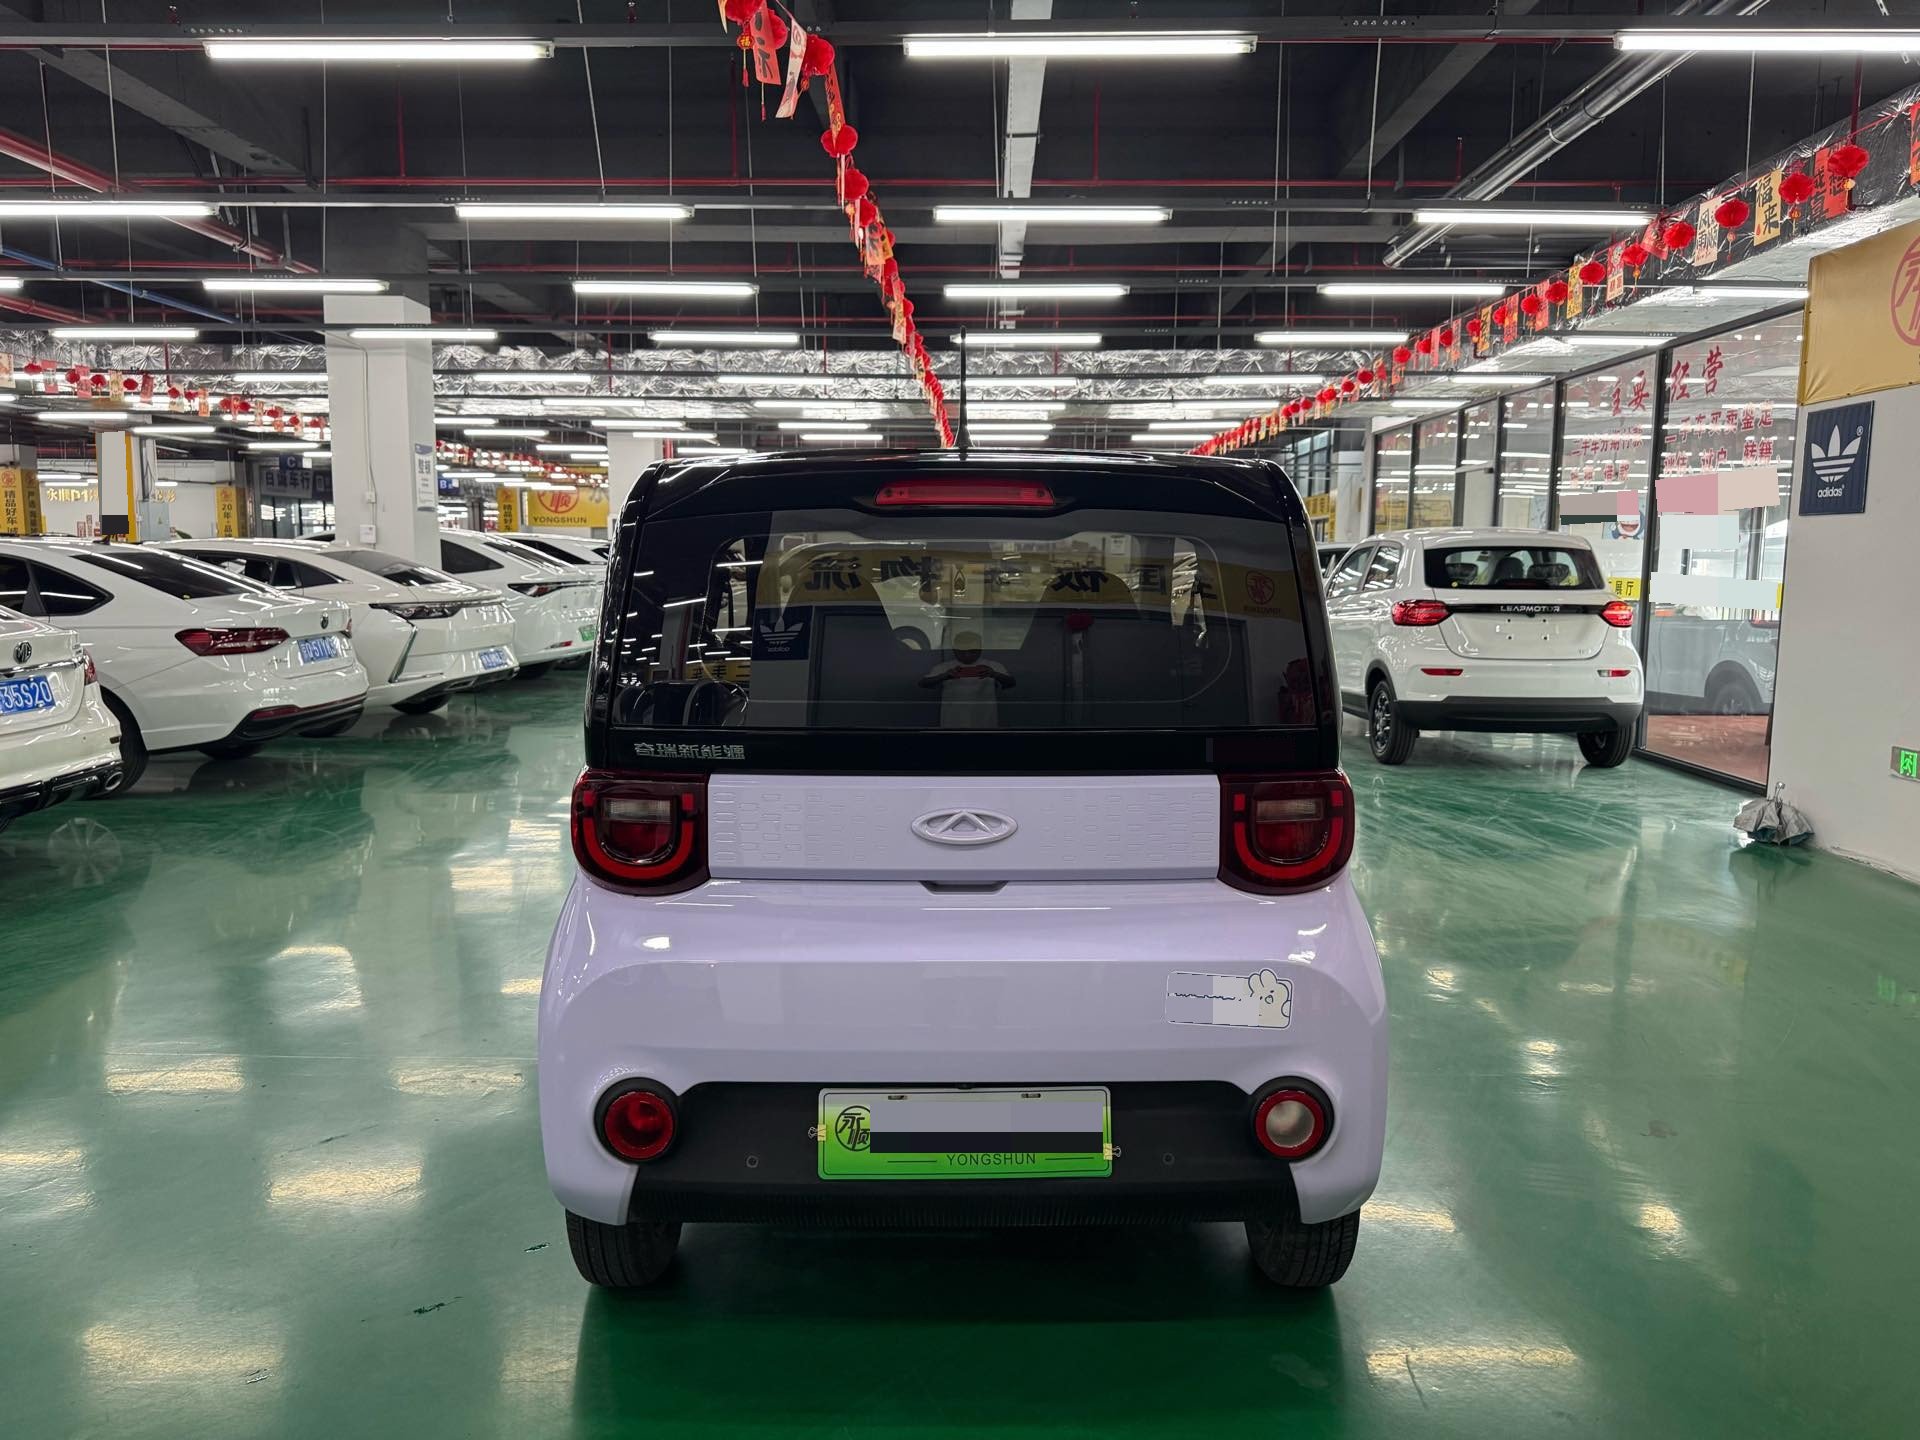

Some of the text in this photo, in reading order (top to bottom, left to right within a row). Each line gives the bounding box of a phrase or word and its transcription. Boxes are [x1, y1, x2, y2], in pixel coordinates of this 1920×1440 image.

[533, 516, 588, 525] YONGSHUN
[1500, 605, 1561, 613] LEAPMOTOR
[633, 742, 746, 760] 奇瑞新能源
[946, 1153, 1036, 1167] YONGSHUN
